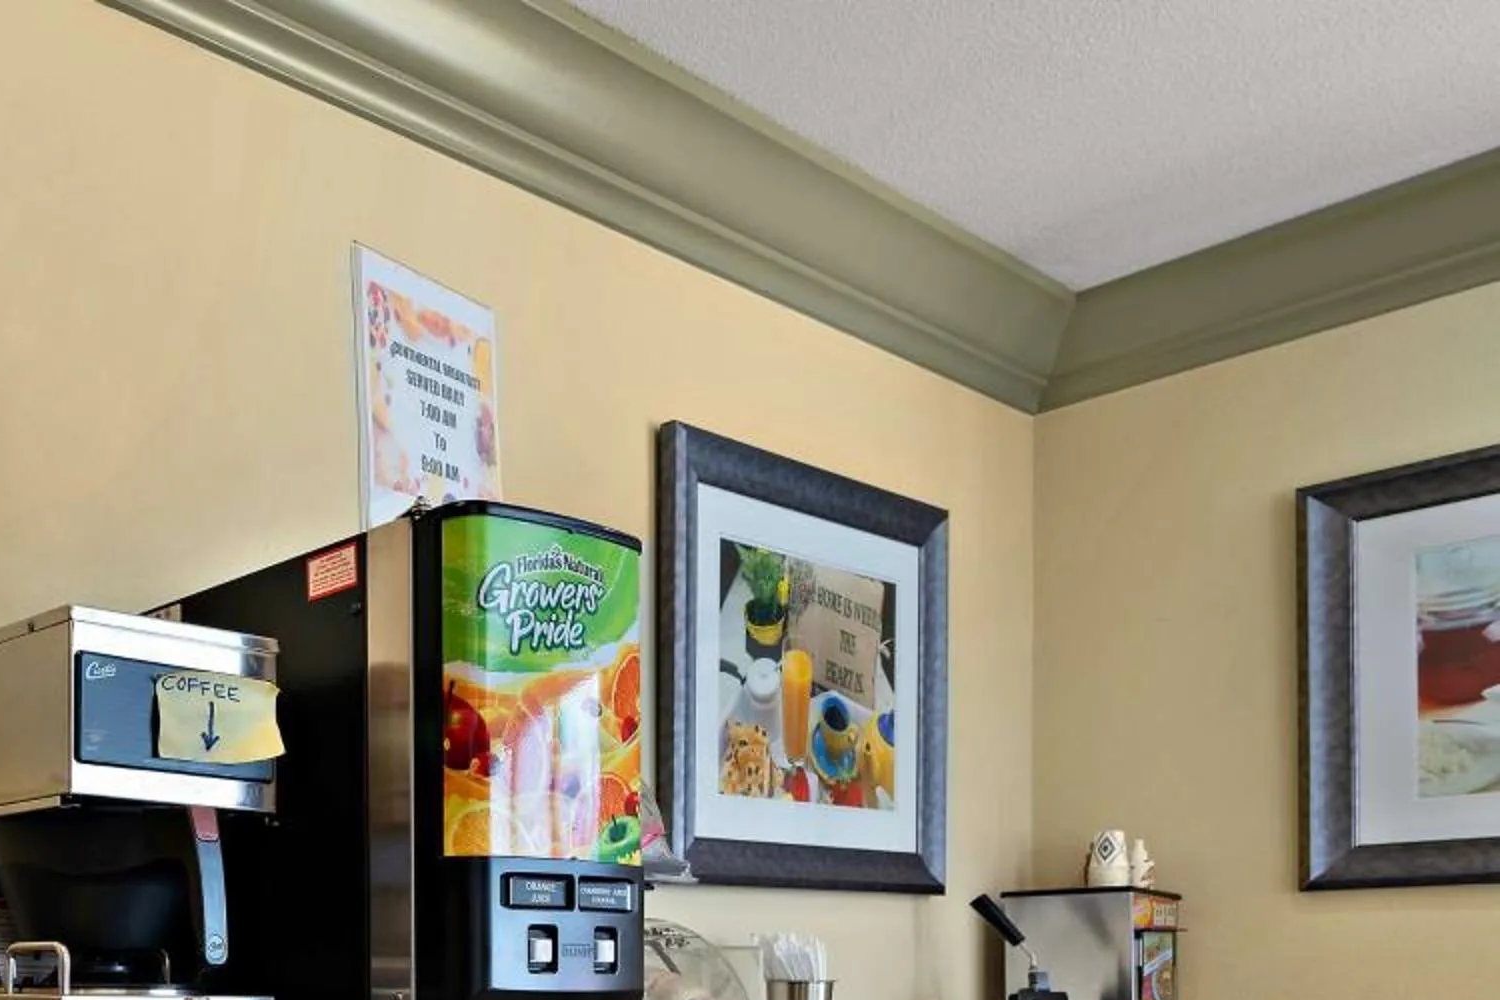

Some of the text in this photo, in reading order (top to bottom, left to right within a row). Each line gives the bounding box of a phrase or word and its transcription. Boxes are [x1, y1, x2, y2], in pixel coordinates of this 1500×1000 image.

[442, 410, 457, 429] AM
[432, 431, 447, 451] TO
[445, 463, 460, 482] AM
[478, 562, 599, 614] Growers
[505, 608, 584, 655] Pride
[161, 675, 240, 703] COFFEE
